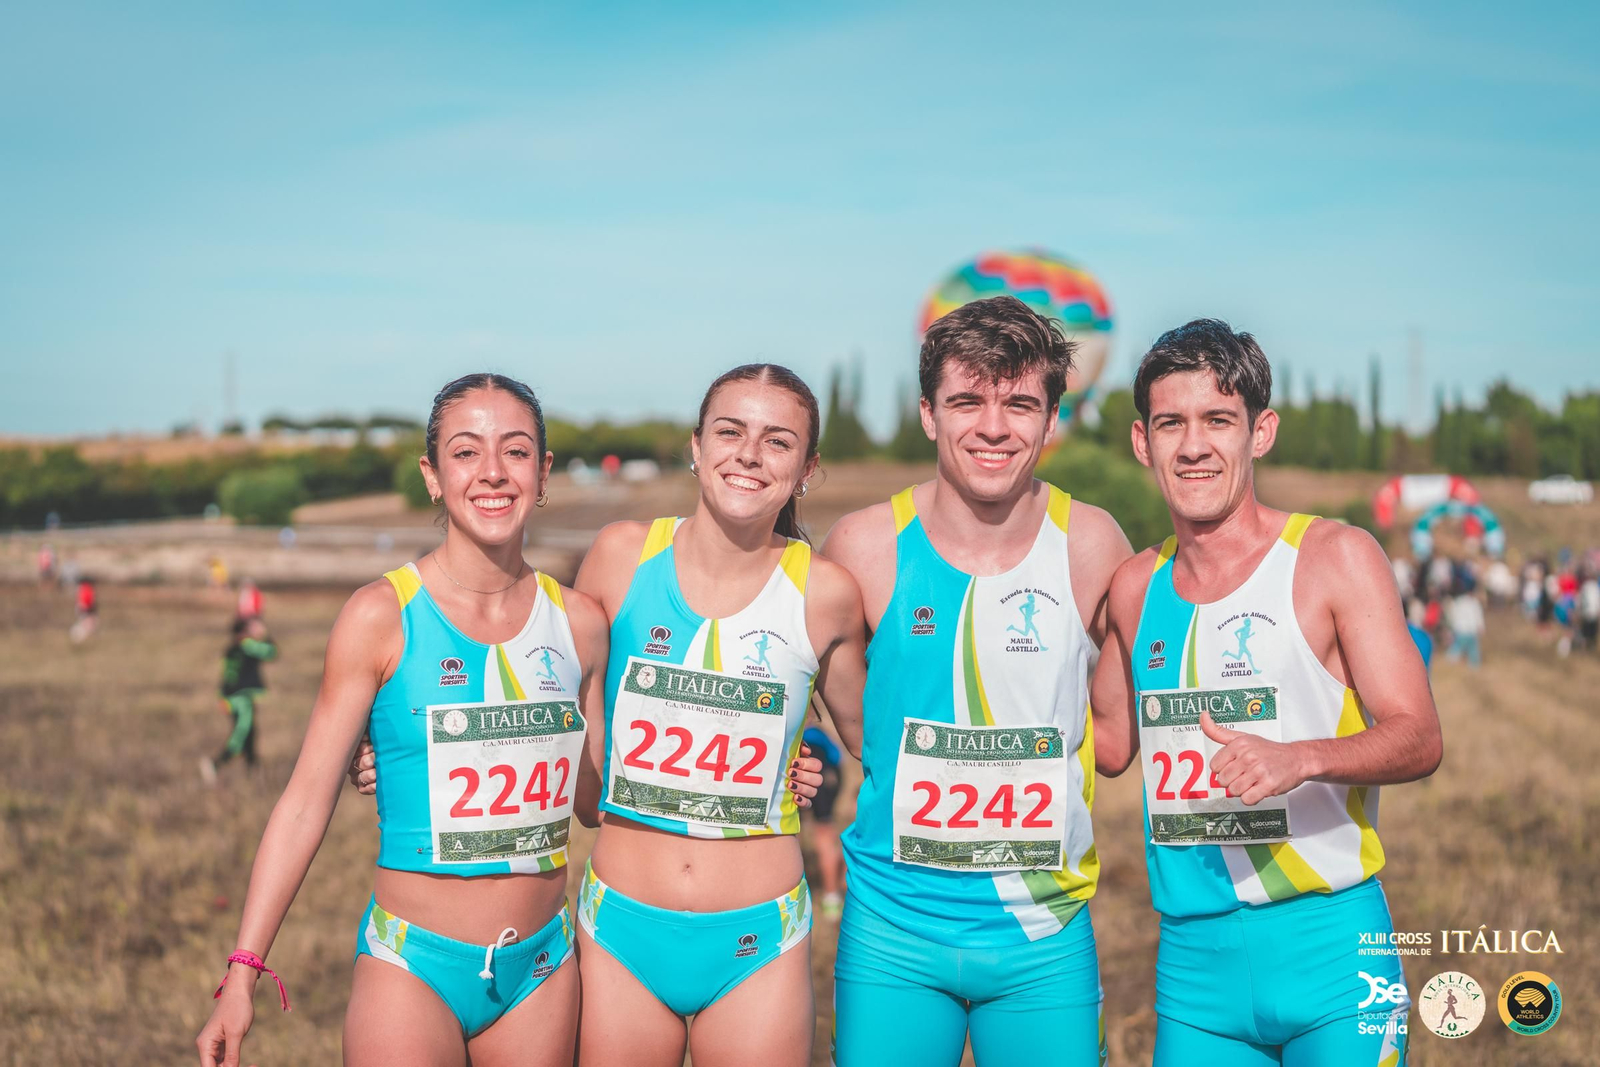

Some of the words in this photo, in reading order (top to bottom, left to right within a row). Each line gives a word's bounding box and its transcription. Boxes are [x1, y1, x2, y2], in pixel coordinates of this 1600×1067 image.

[1000, 590, 1022, 604] Escuela
[1033, 588, 1059, 605] Atletismo
[1217, 615, 1239, 630] Escuela
[1250, 612, 1276, 626] Atletismo
[742, 670, 770, 678] CASTILLO
[666, 674, 745, 700] ITÁLICA
[480, 707, 554, 729] ITÁLICA
[680, 703, 703, 712] MAURI
[705, 707, 740, 717] CASTILLO
[522, 736, 553, 744] CASTILLO
[946, 731, 1024, 750] ITÁLICA
[624, 720, 767, 784] 2242
[449, 757, 570, 818] 2242
[911, 781, 1053, 828] 2242
